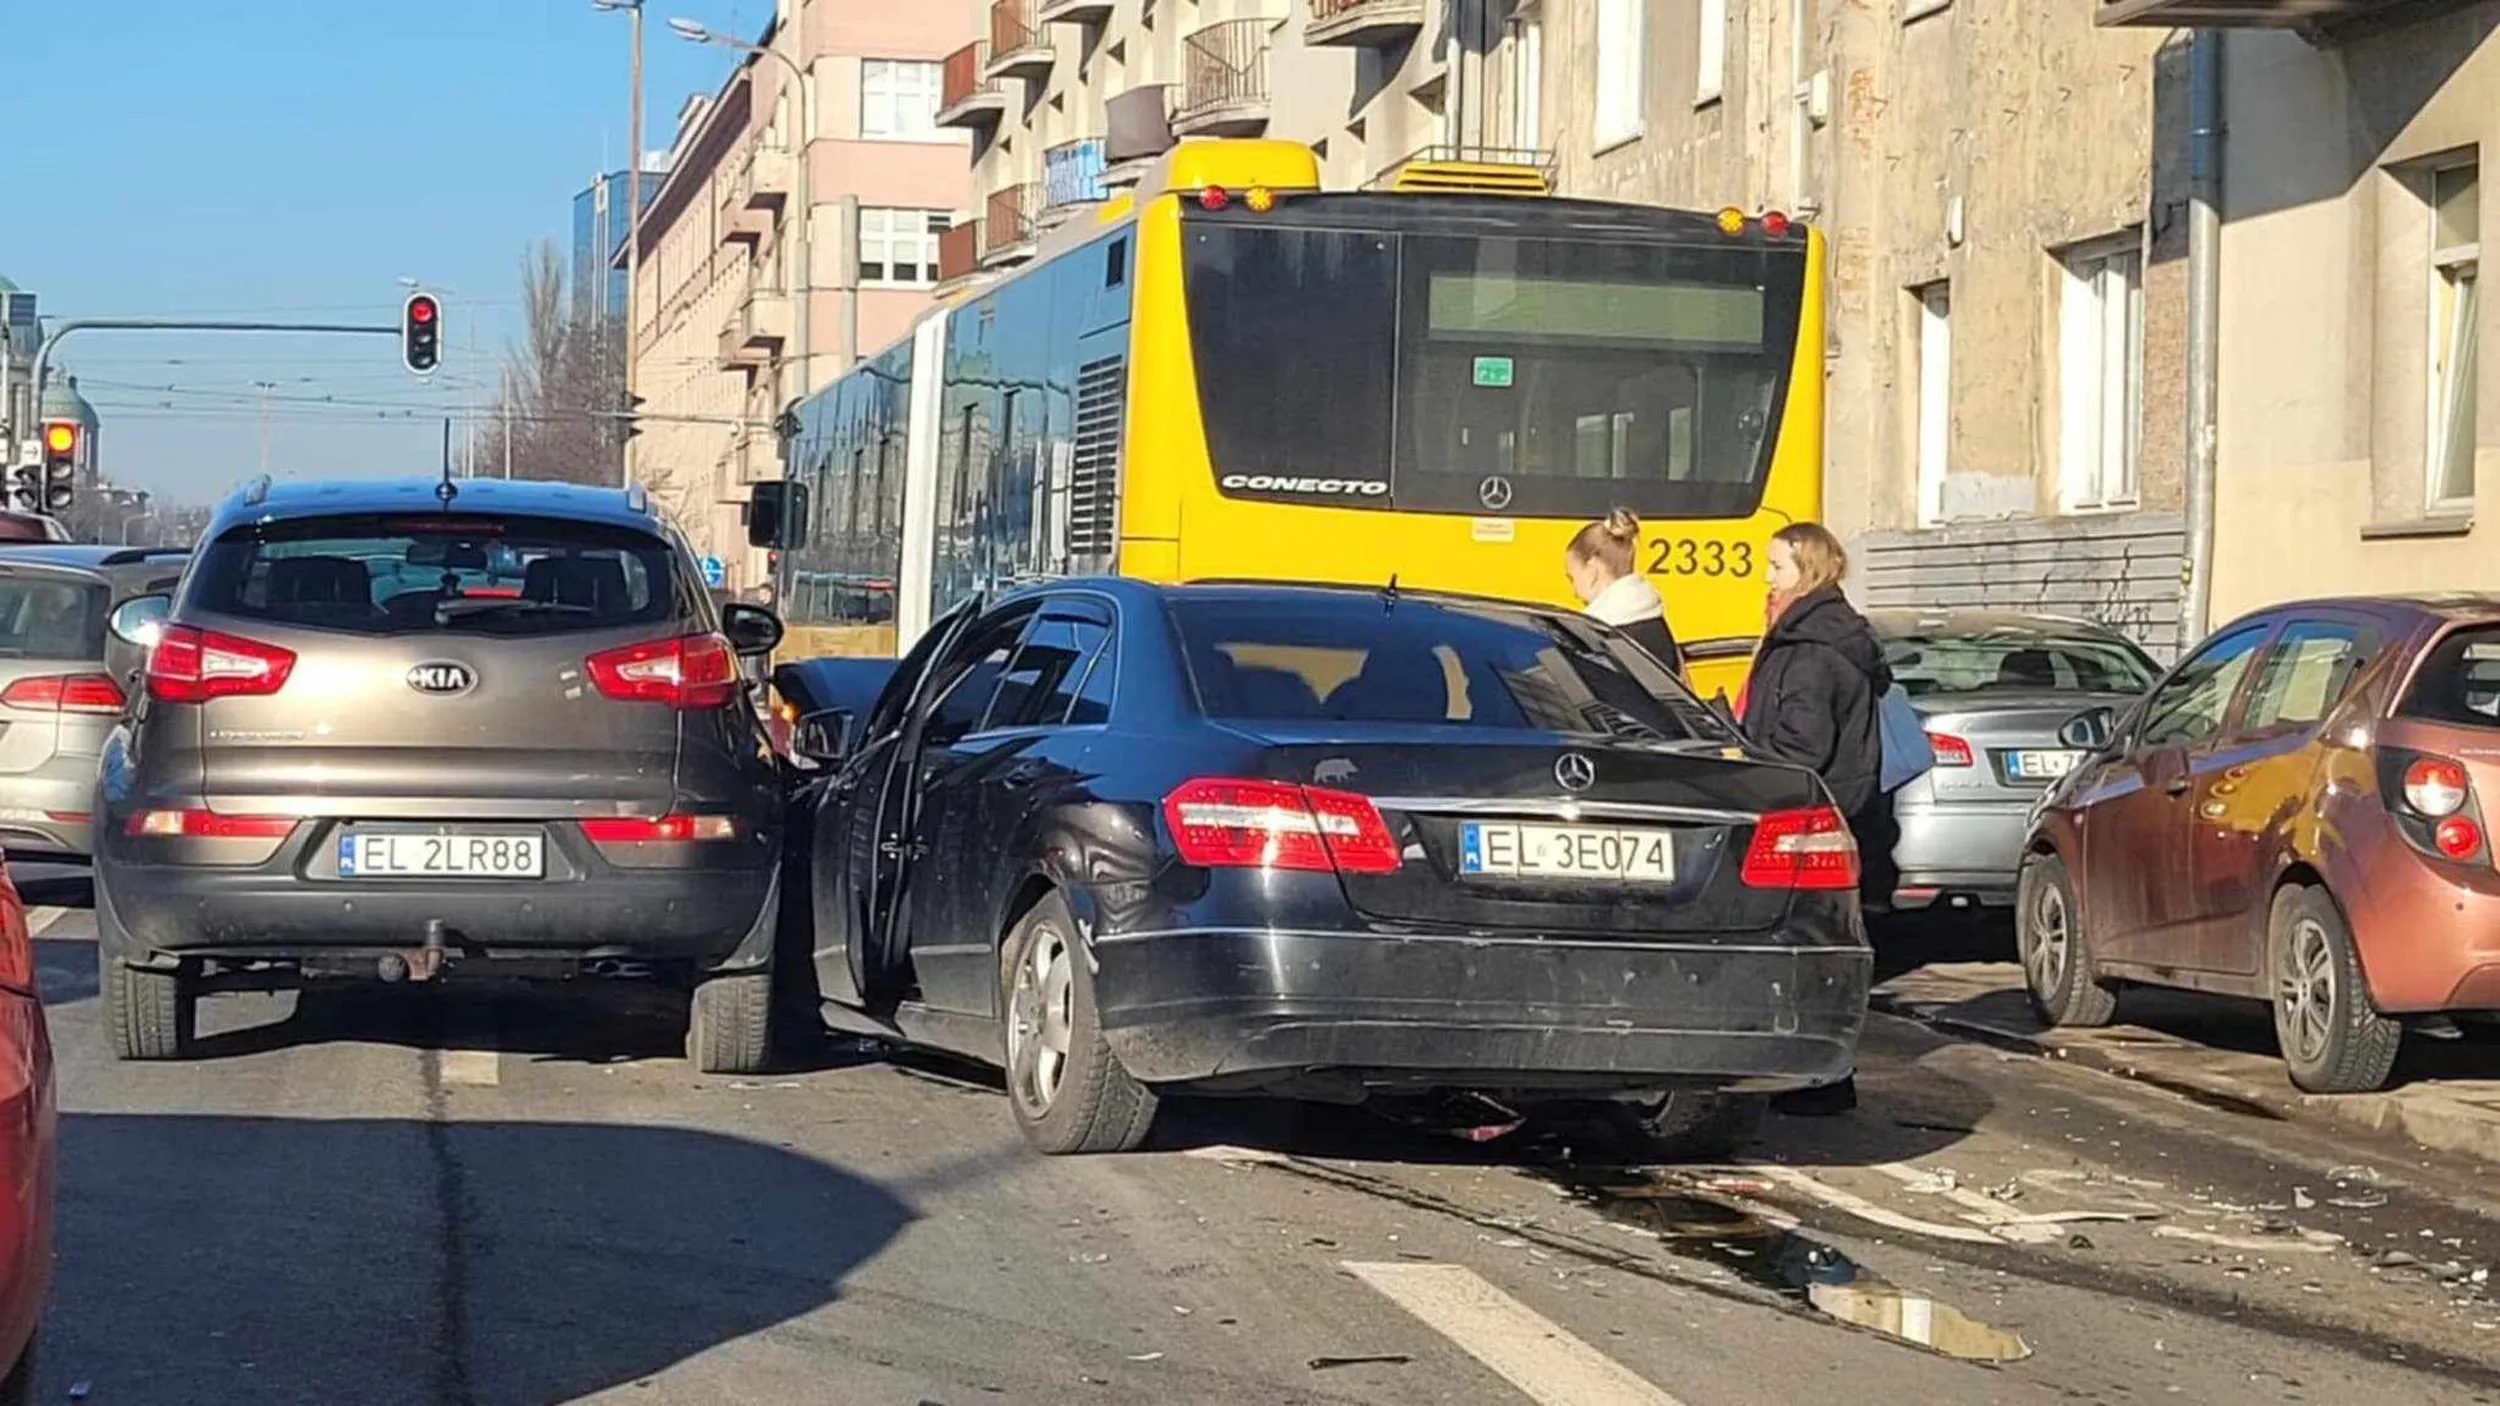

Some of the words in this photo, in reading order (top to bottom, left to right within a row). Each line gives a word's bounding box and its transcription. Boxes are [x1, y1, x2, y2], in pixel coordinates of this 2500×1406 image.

[1222, 474, 1388, 495] CONECTO
[1647, 538, 1753, 578] 2333
[420, 667, 465, 688] KIA
[2022, 753, 2054, 774] EL
[365, 838, 407, 870] EL
[423, 838, 532, 872] 2LR88
[1487, 831, 1539, 867] EL
[1555, 833, 1665, 874] 3E074
